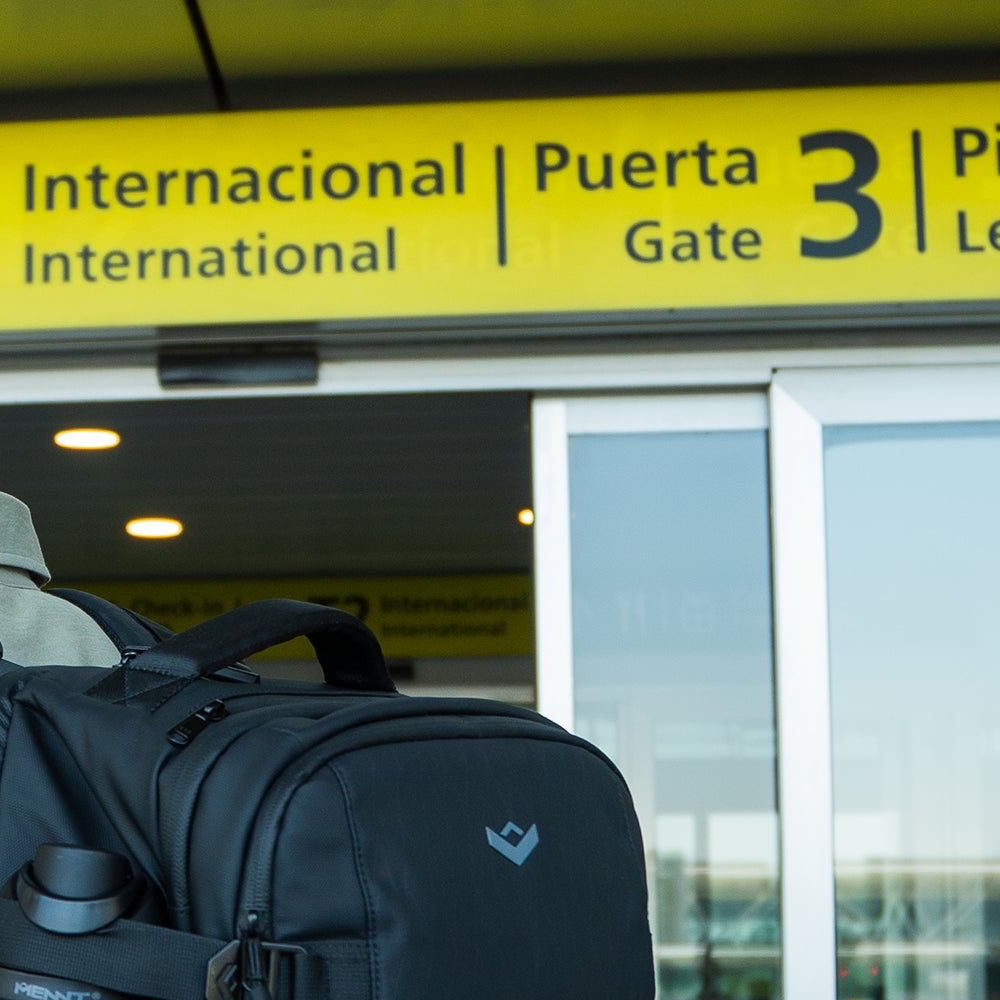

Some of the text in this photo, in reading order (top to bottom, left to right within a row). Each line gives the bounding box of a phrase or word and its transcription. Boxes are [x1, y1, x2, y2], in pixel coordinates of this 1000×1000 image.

[25, 143, 465, 212] Internacional
[535, 141, 758, 192] Puerta
[799, 130, 883, 260] 3
[25, 227, 395, 284] International
[625, 221, 762, 264] Gate
